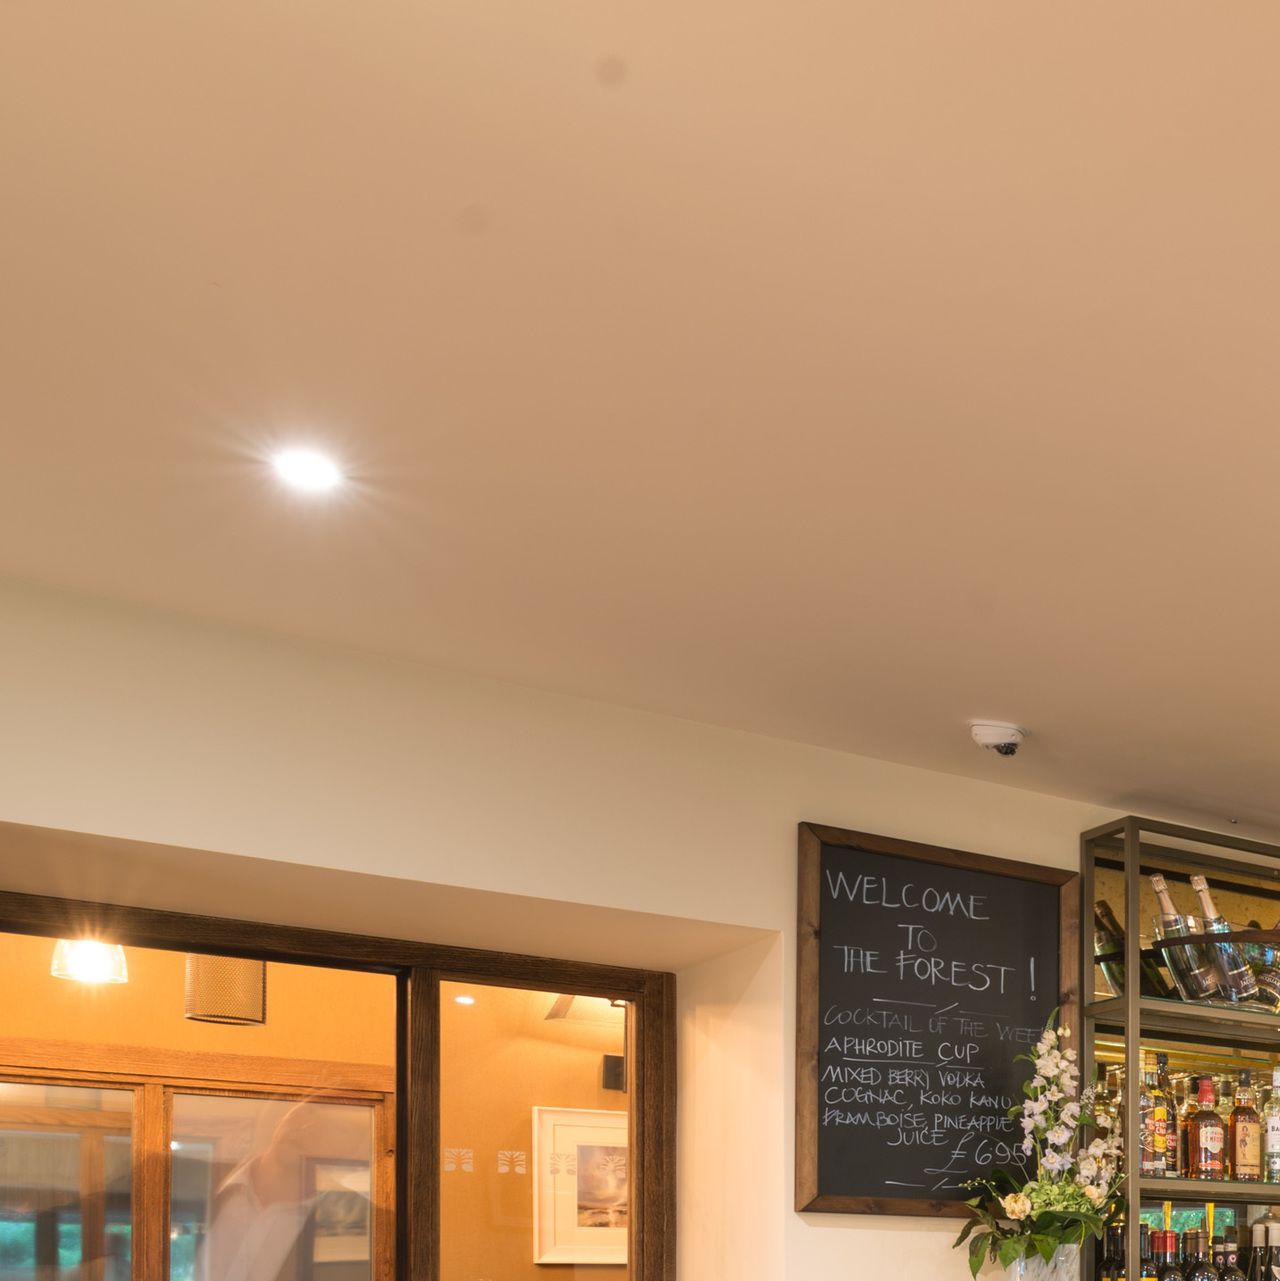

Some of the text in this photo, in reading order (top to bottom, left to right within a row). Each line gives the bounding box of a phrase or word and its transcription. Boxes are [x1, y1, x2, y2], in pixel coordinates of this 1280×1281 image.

[826, 868, 990, 919] WELCOME
[897, 924, 937, 952] TO
[832, 946, 888, 973] THE
[895, 950, 1016, 994] FOREST
[823, 1005, 1043, 1044] COCKTAIL OF THE WEE
[824, 1037, 980, 1063] APHRODITE CUP
[821, 1065, 985, 1089] MIXED BERRY VODKA
[920, 1090, 961, 1106] KOKO
[970, 1091, 1012, 1109] KANU
[887, 1127, 949, 1145] JUICE
